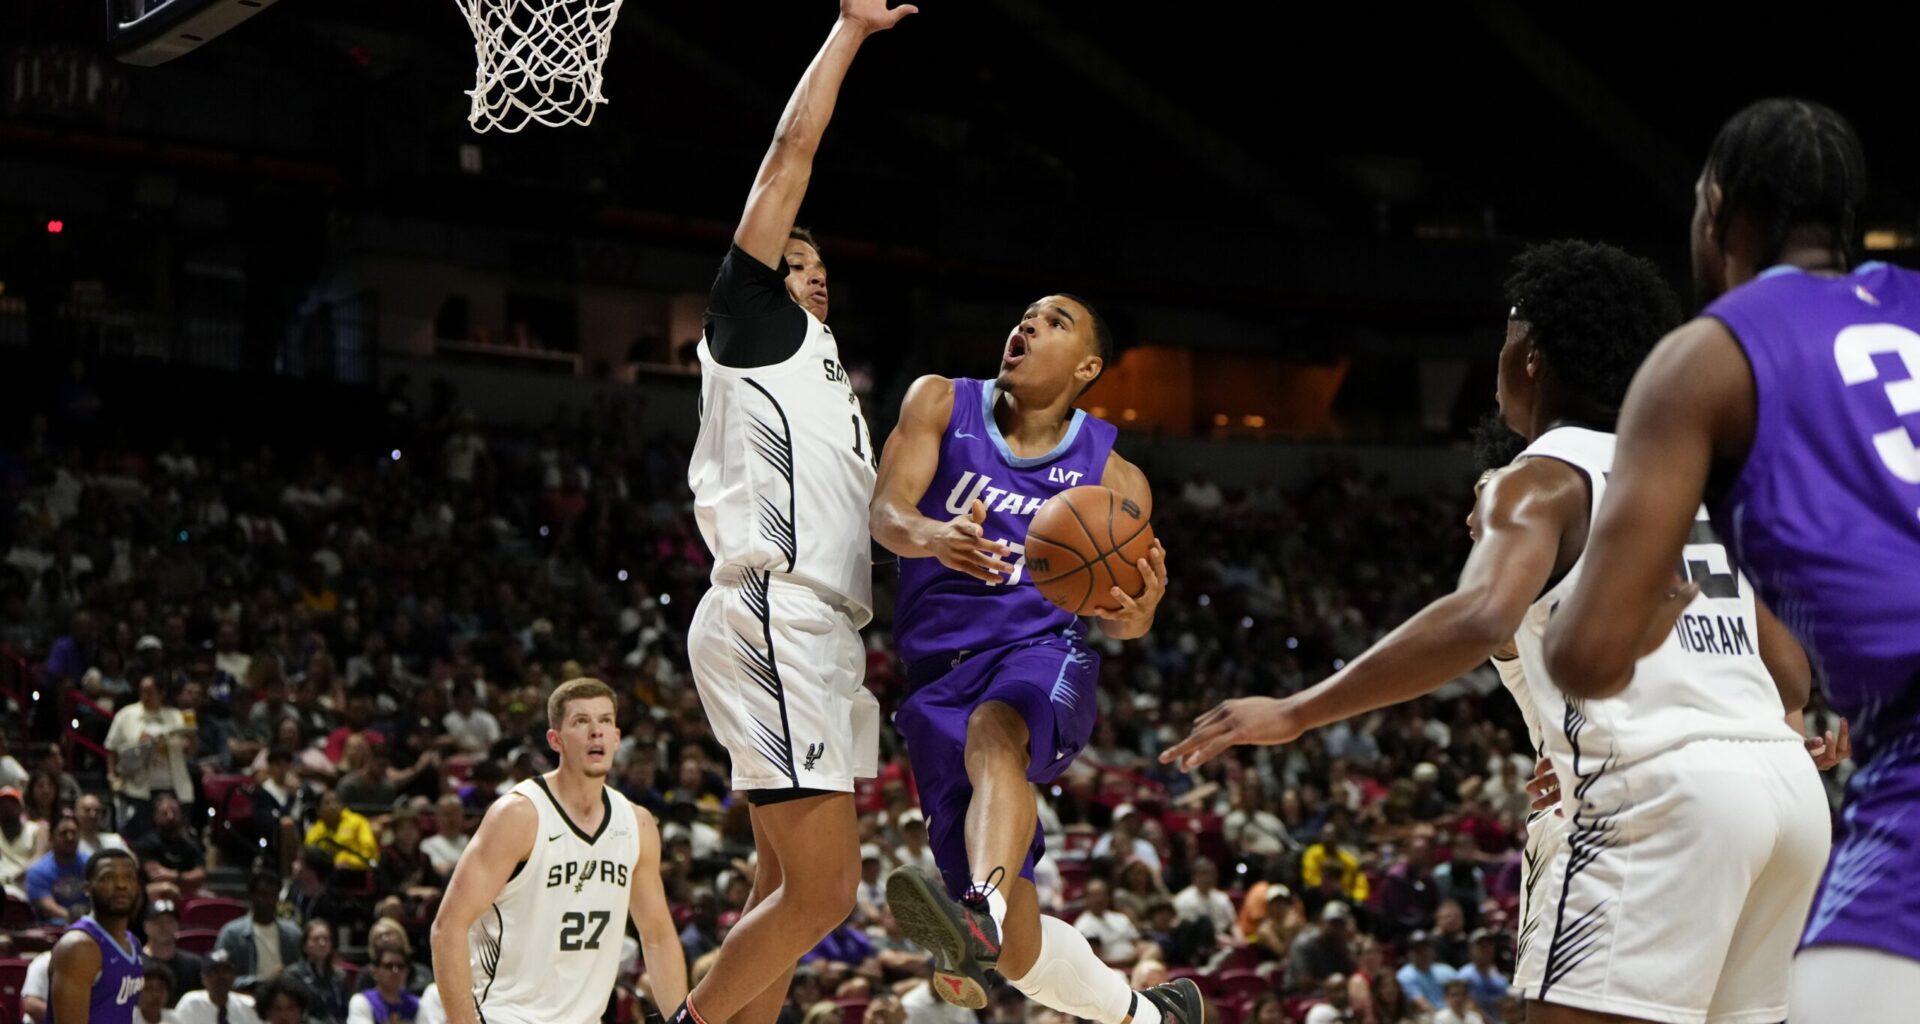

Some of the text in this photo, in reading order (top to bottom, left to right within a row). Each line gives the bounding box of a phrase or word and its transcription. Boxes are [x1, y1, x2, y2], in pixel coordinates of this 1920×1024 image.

[945, 471, 1049, 515] UTAH
[1048, 467, 1083, 487] LVT
[547, 860, 628, 890] SPURS
[560, 910, 611, 951] 27
